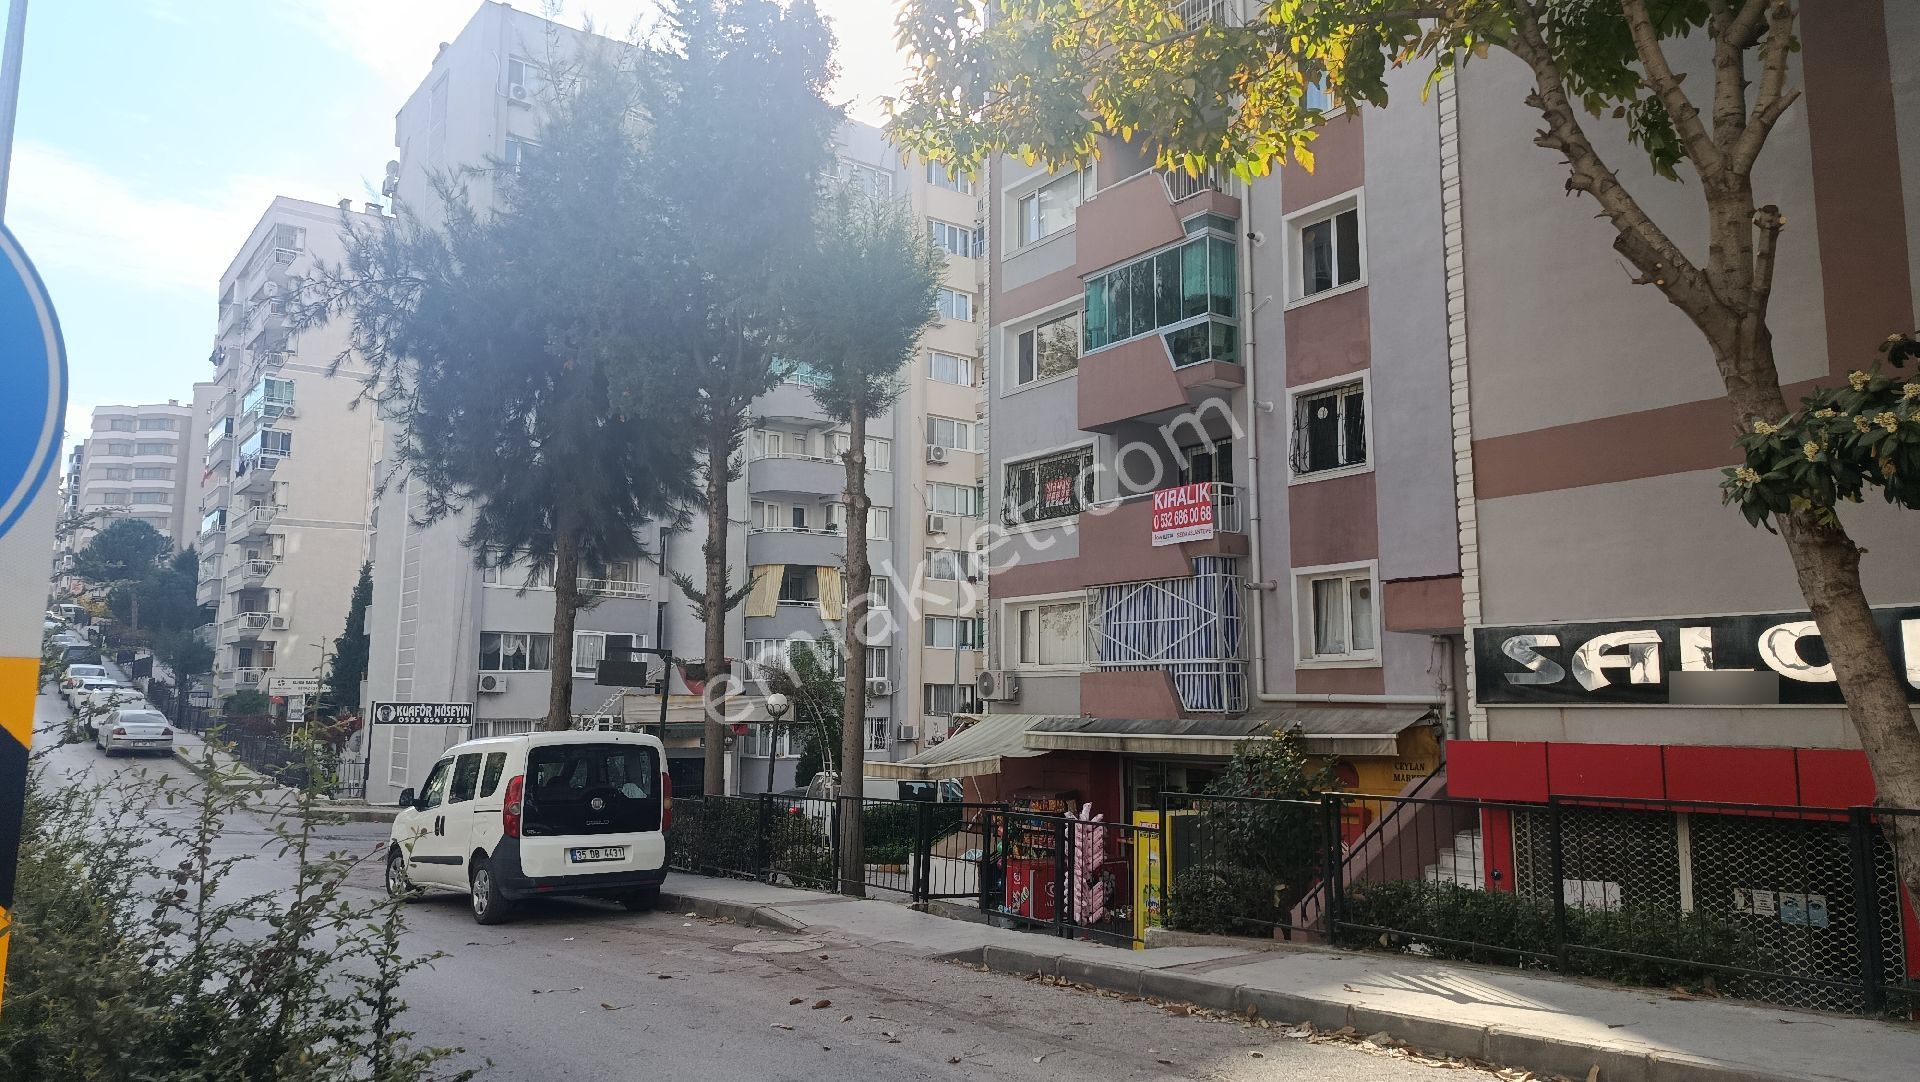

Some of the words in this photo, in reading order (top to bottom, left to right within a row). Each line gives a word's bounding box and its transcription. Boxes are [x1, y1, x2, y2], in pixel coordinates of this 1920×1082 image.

[1153, 515, 1159, 529] 0
[1160, 512, 1173, 528] 532
[1174, 509, 1188, 525] 686
[1189, 507, 1199, 522] 00
[1200, 505, 1211, 521] 68
[1393, 773, 1427, 782] MAR
[576, 850, 586, 860] 35
[604, 848, 622, 857] 4431
